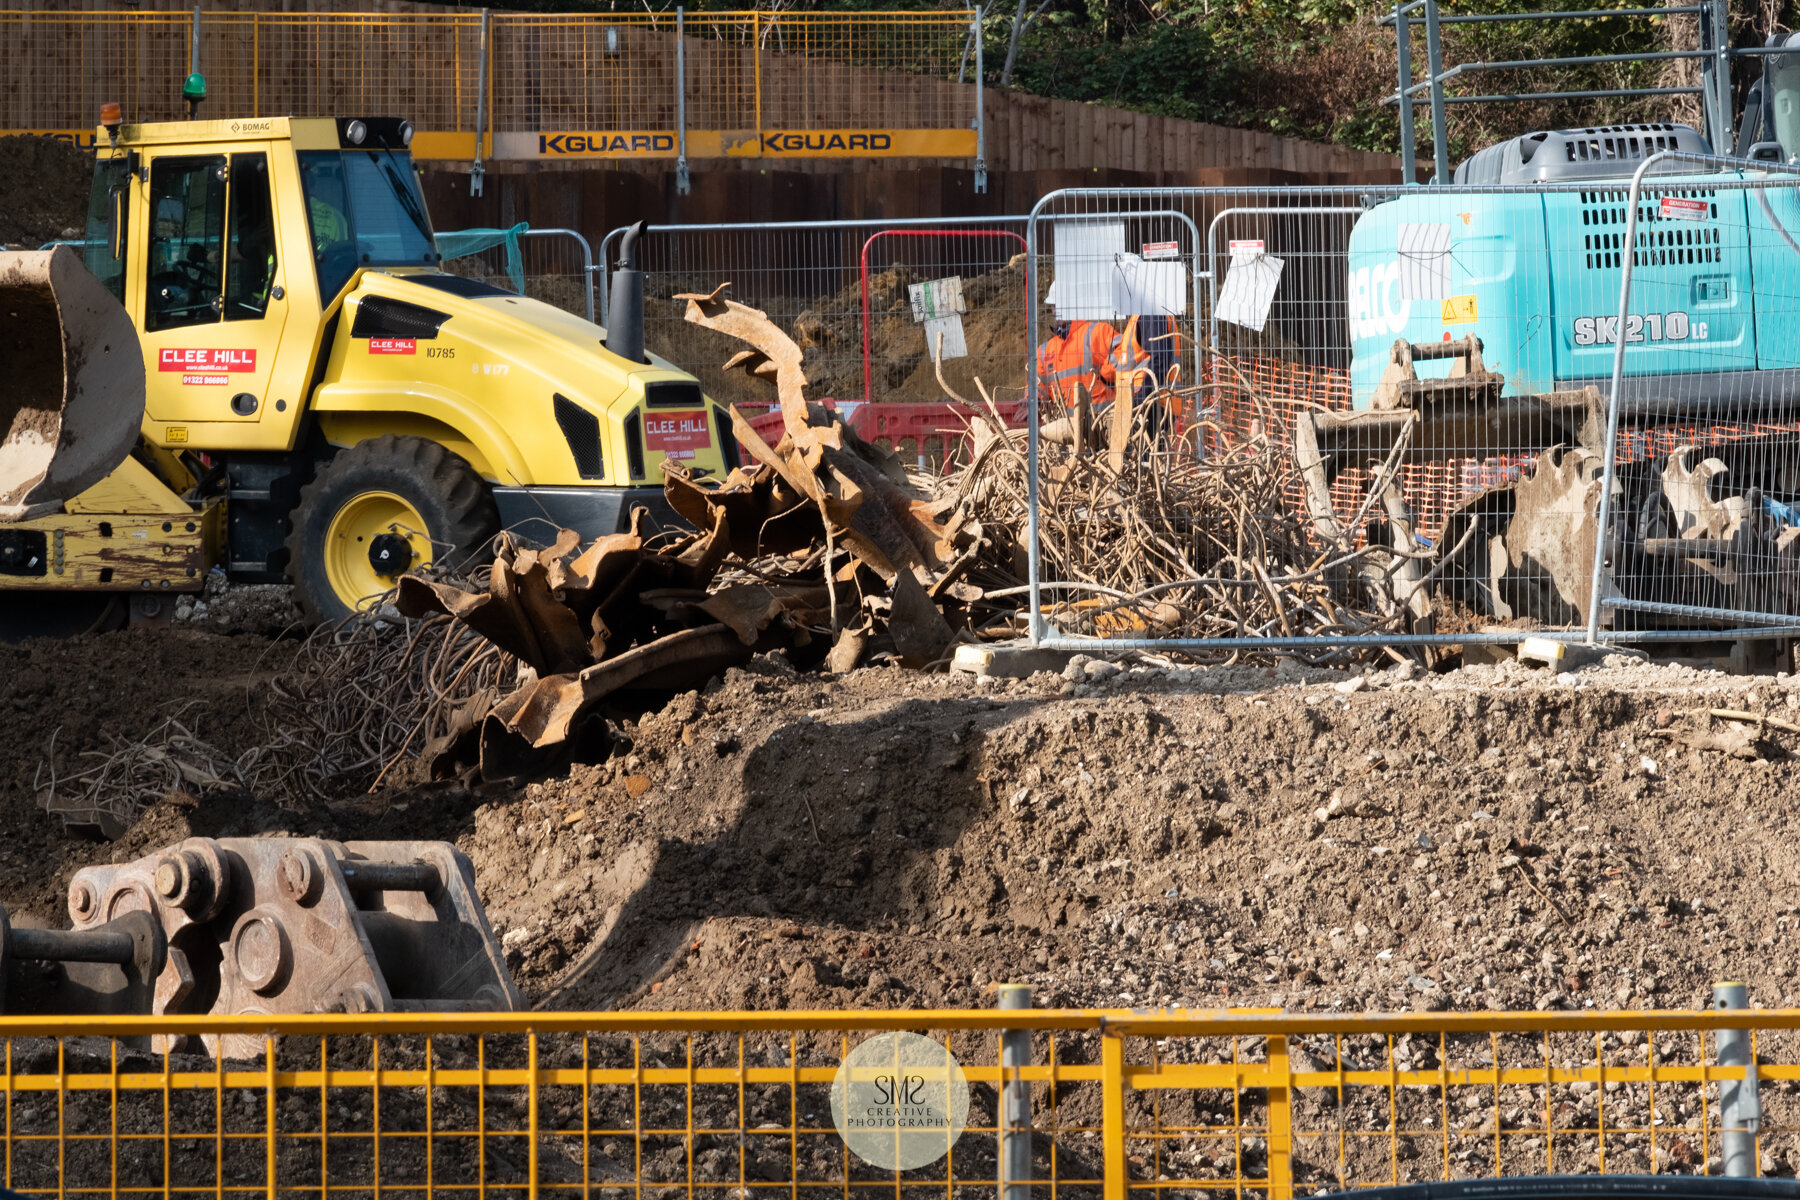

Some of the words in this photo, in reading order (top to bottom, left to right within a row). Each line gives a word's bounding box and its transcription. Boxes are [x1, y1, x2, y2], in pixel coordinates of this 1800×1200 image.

[242, 123, 270, 131] BOMAG
[539, 135, 674, 154] KGUARD
[760, 133, 891, 152] KGUARD
[1574, 312, 1690, 346] SK210
[1691, 322, 1708, 340] LC
[371, 341, 393, 349] CLEE
[395, 341, 414, 349] HILL
[162, 350, 208, 363] CLEE
[214, 351, 253, 363] HILL
[427, 347, 456, 358] 10785
[183, 375, 203, 384] 01322
[647, 421, 676, 434] CLEE
[680, 420, 706, 432] HILL
